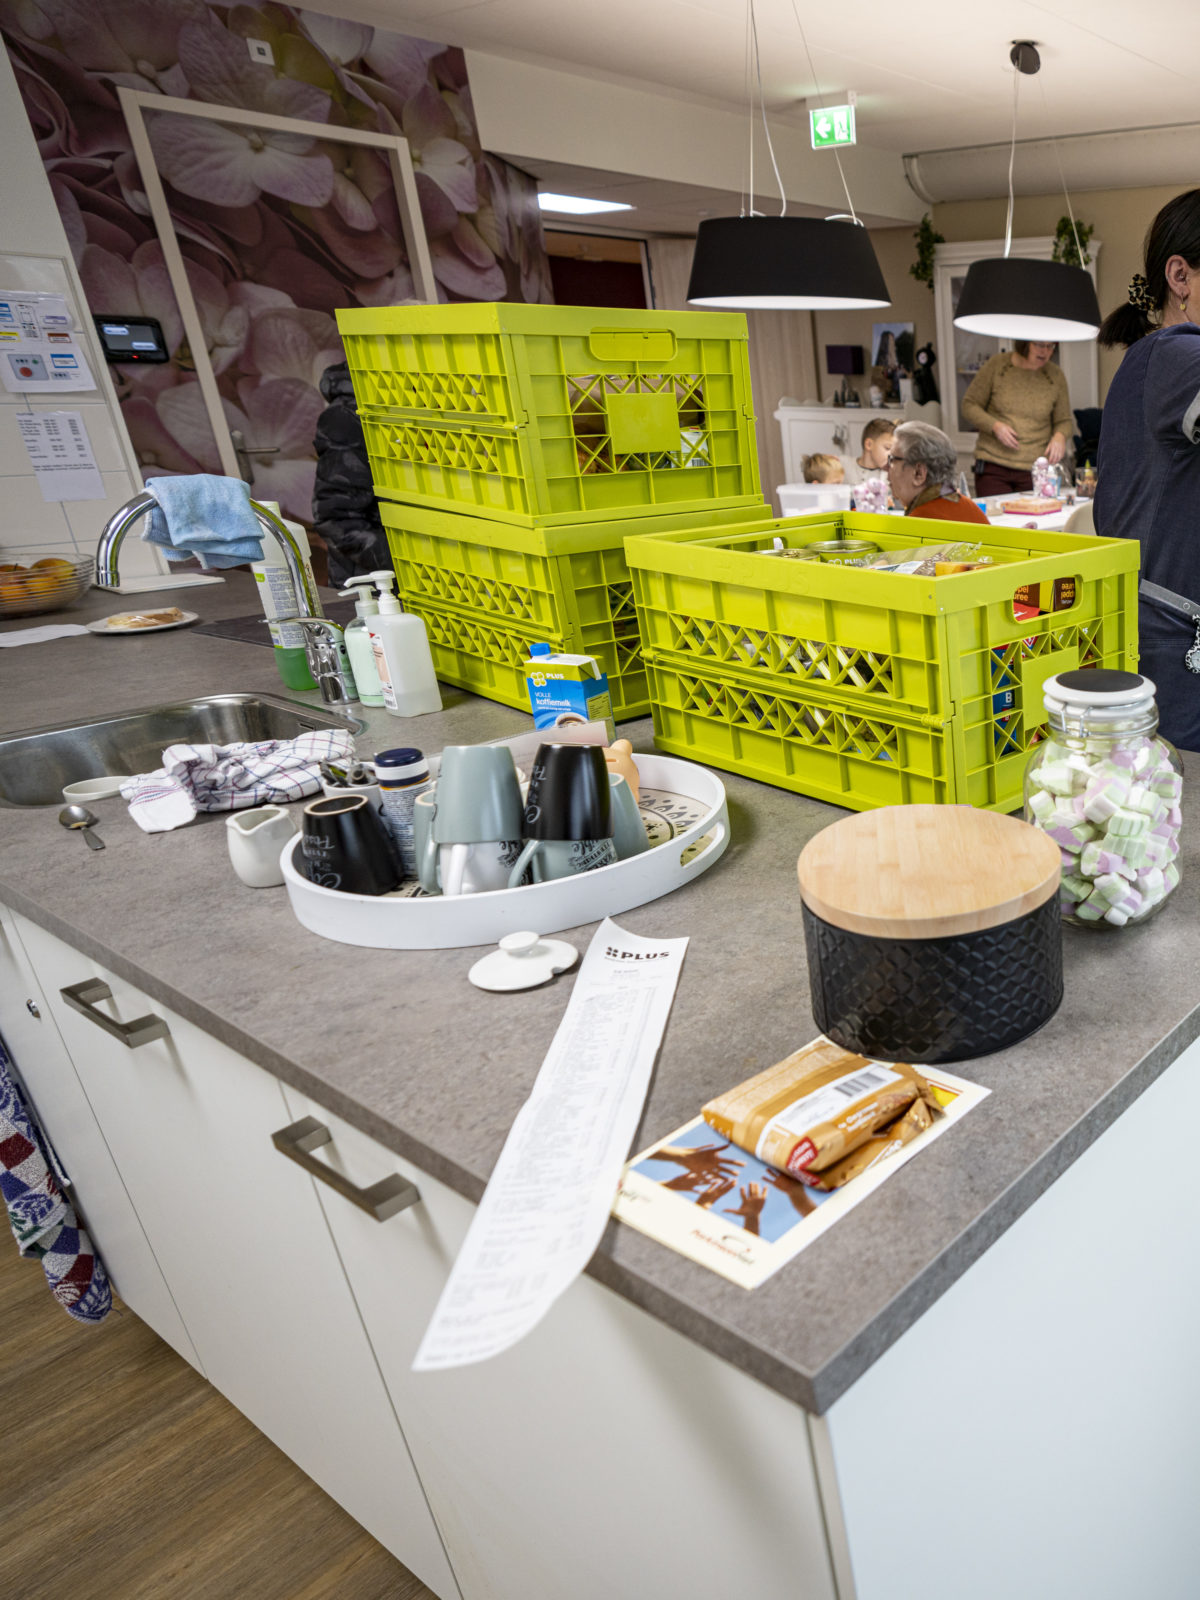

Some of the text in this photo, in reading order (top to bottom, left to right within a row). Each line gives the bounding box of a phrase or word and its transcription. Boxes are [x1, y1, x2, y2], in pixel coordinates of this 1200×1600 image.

[545, 672, 565, 680] PLUS
[536, 698, 571, 707] koffiemelk
[621, 951, 670, 961] PLUS
